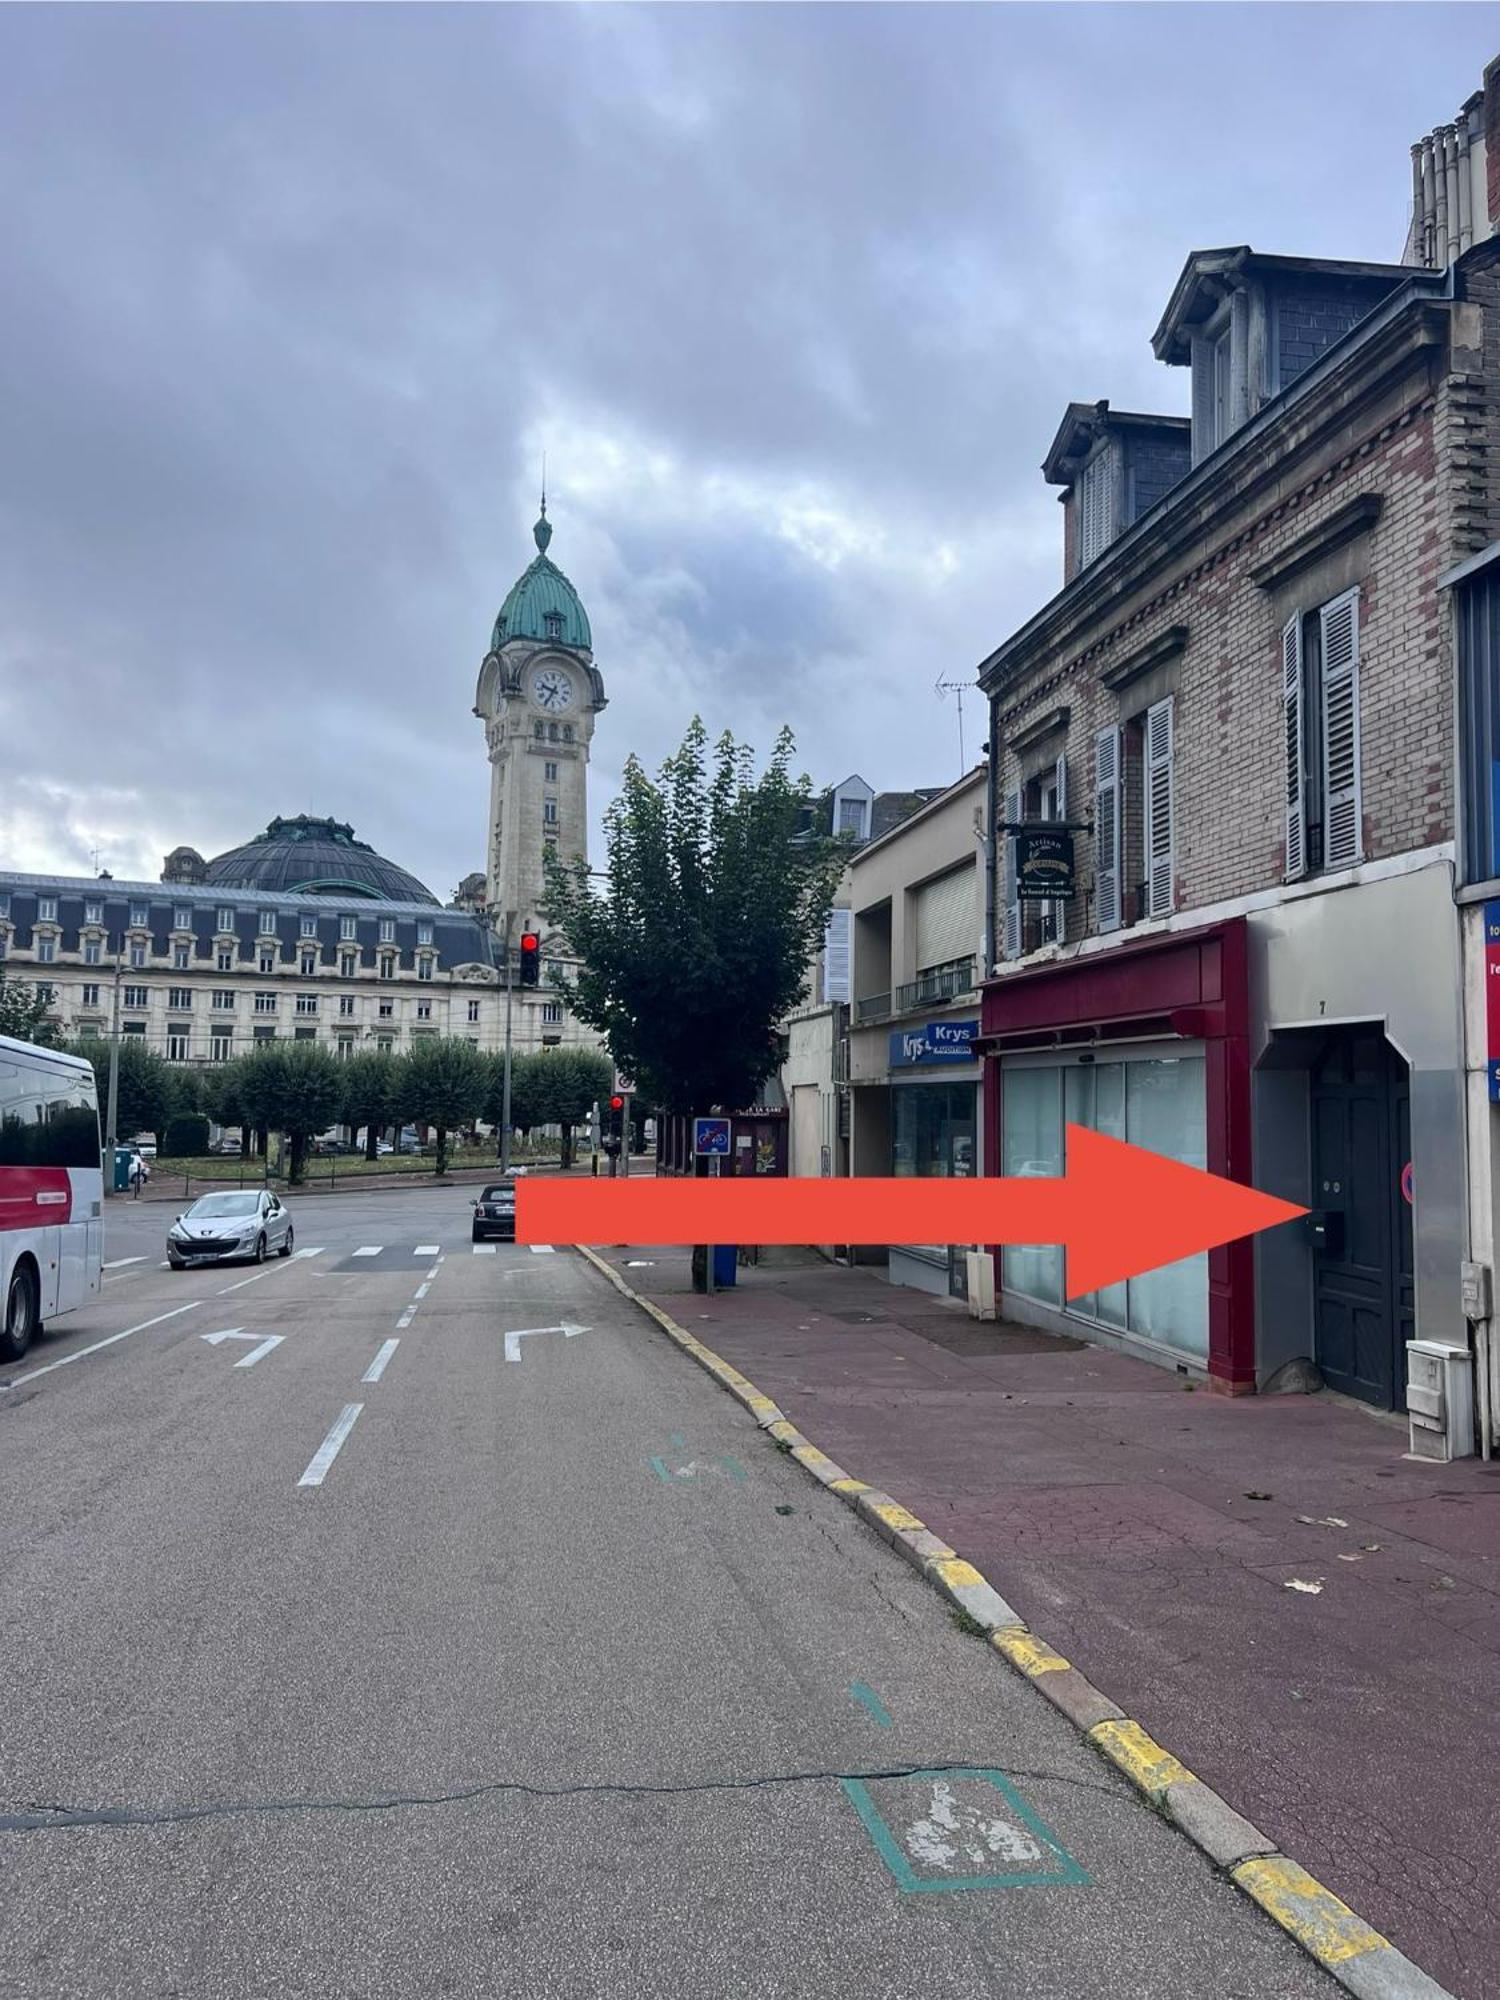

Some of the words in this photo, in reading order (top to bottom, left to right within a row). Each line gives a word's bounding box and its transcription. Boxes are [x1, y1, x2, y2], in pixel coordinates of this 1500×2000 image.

[1028, 836, 1062, 849] Artisan
[1319, 1000, 1326, 1015] 7
[935, 1026, 970, 1043] Krys
[903, 1034, 923, 1062] Krys
